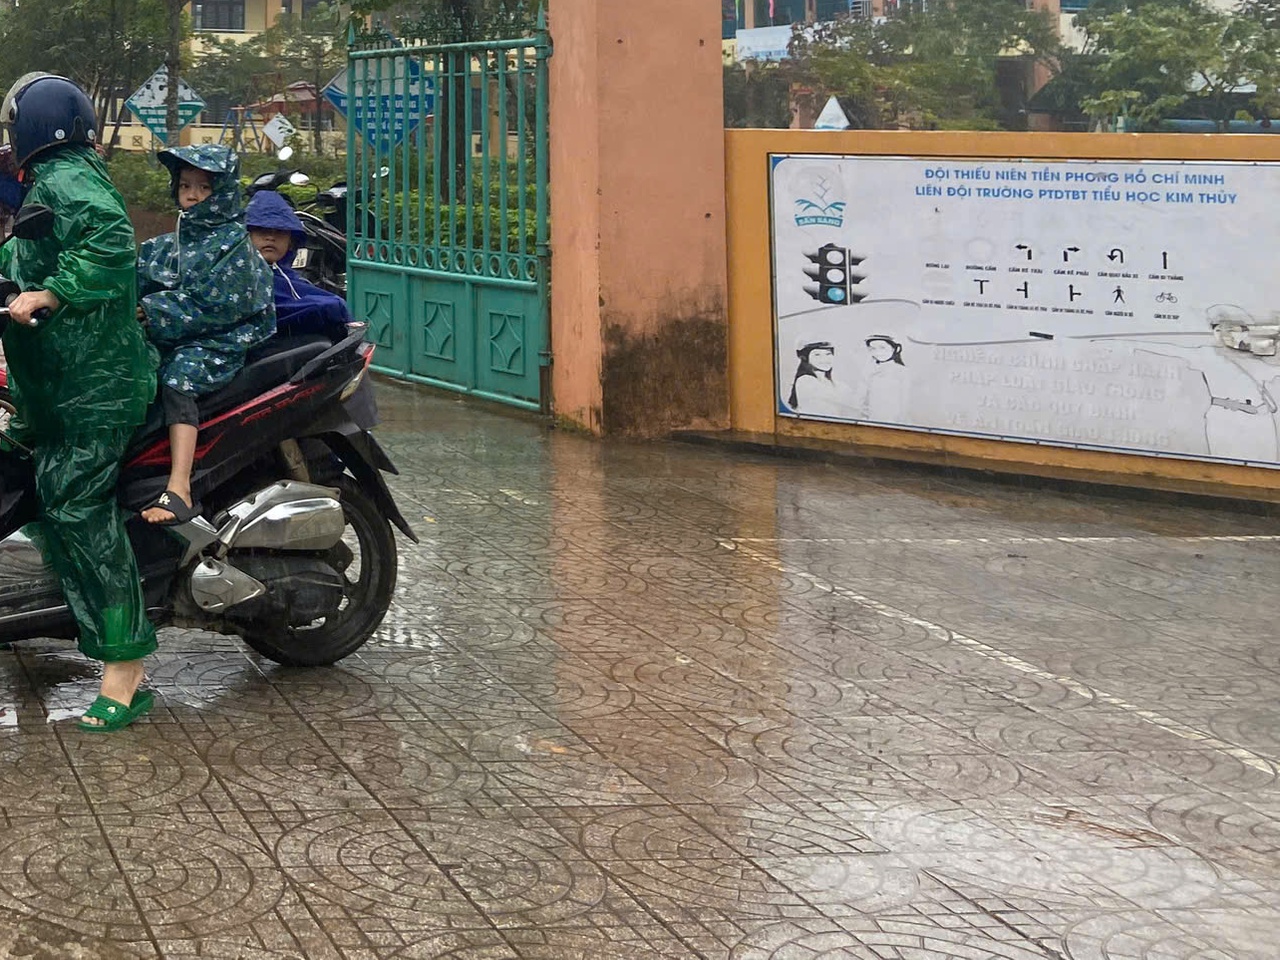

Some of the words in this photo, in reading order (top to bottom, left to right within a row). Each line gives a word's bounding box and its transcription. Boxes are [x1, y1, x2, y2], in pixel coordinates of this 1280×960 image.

[924, 167, 950, 182] ĐỘI
[954, 166, 991, 180] THIẾU
[995, 168, 1027, 181] NIÊN
[1031, 167, 1061, 182] TIỀN
[1065, 171, 1119, 183] PHONG
[1124, 168, 1147, 183] HỒ
[1151, 170, 1180, 184] CHÍ
[1184, 173, 1225, 185] MINH
[915, 184, 942, 197] LIÊN
[946, 184, 971, 200] ĐỘI
[976, 186, 1034, 199] TRƯỜNG
[1038, 188, 1088, 201] PTDTBT
[1092, 185, 1121, 201] TIỂU
[1125, 191, 1160, 205] HỌC
[1165, 192, 1194, 203] KIM
